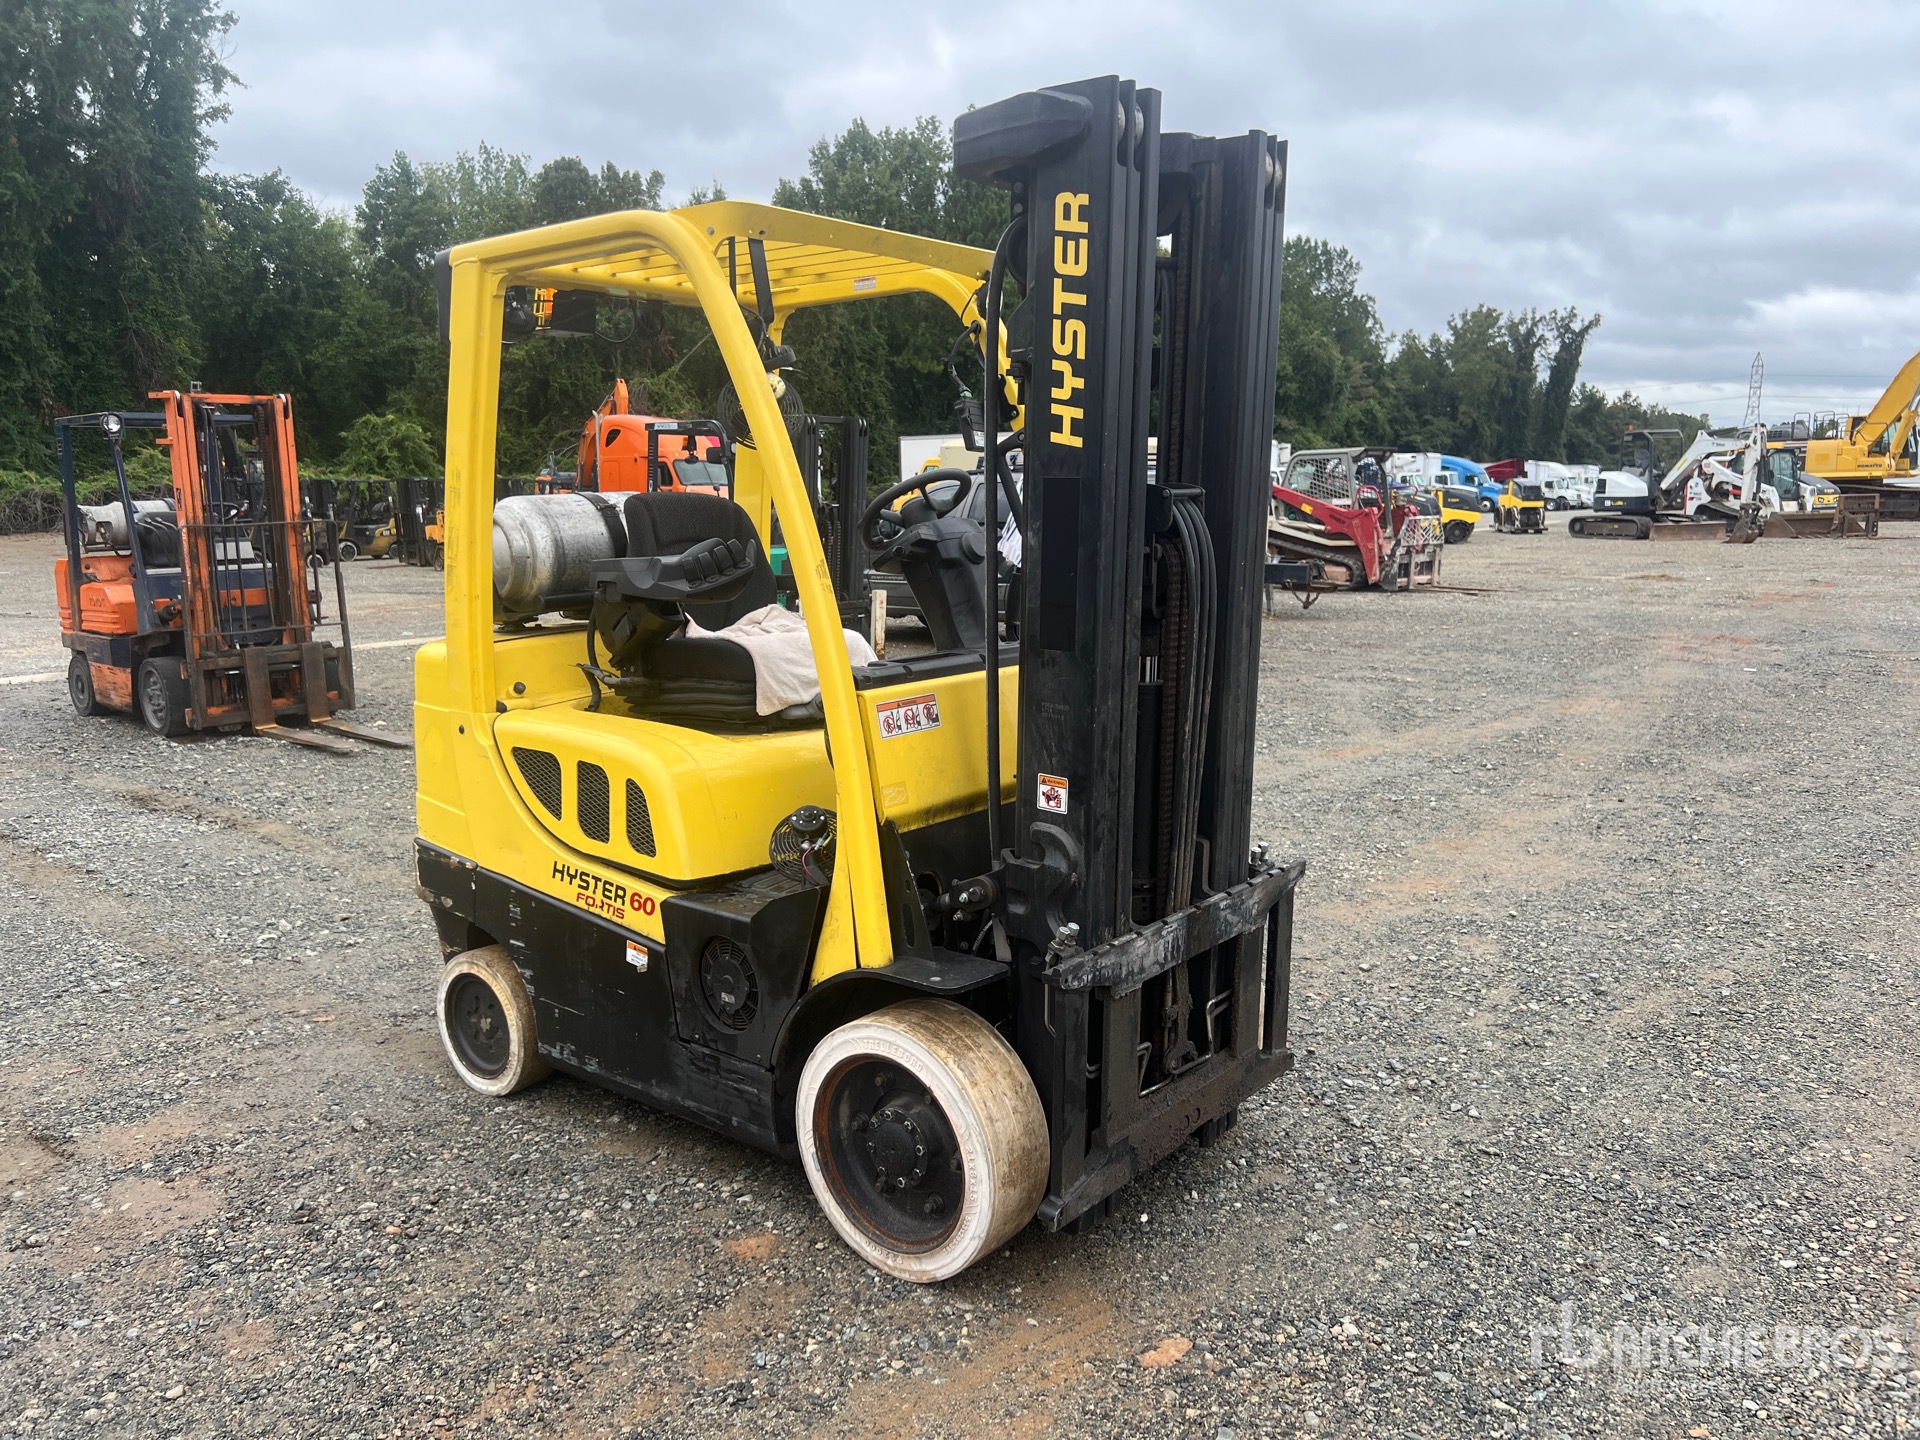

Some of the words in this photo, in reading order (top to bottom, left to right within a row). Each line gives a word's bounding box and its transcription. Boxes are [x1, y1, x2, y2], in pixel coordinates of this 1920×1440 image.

[1050, 191, 1089, 448] HYSTER
[552, 861, 627, 906] HYSTER
[630, 892, 656, 916] 60
[863, 1039, 924, 1073] TRELLEBORG
